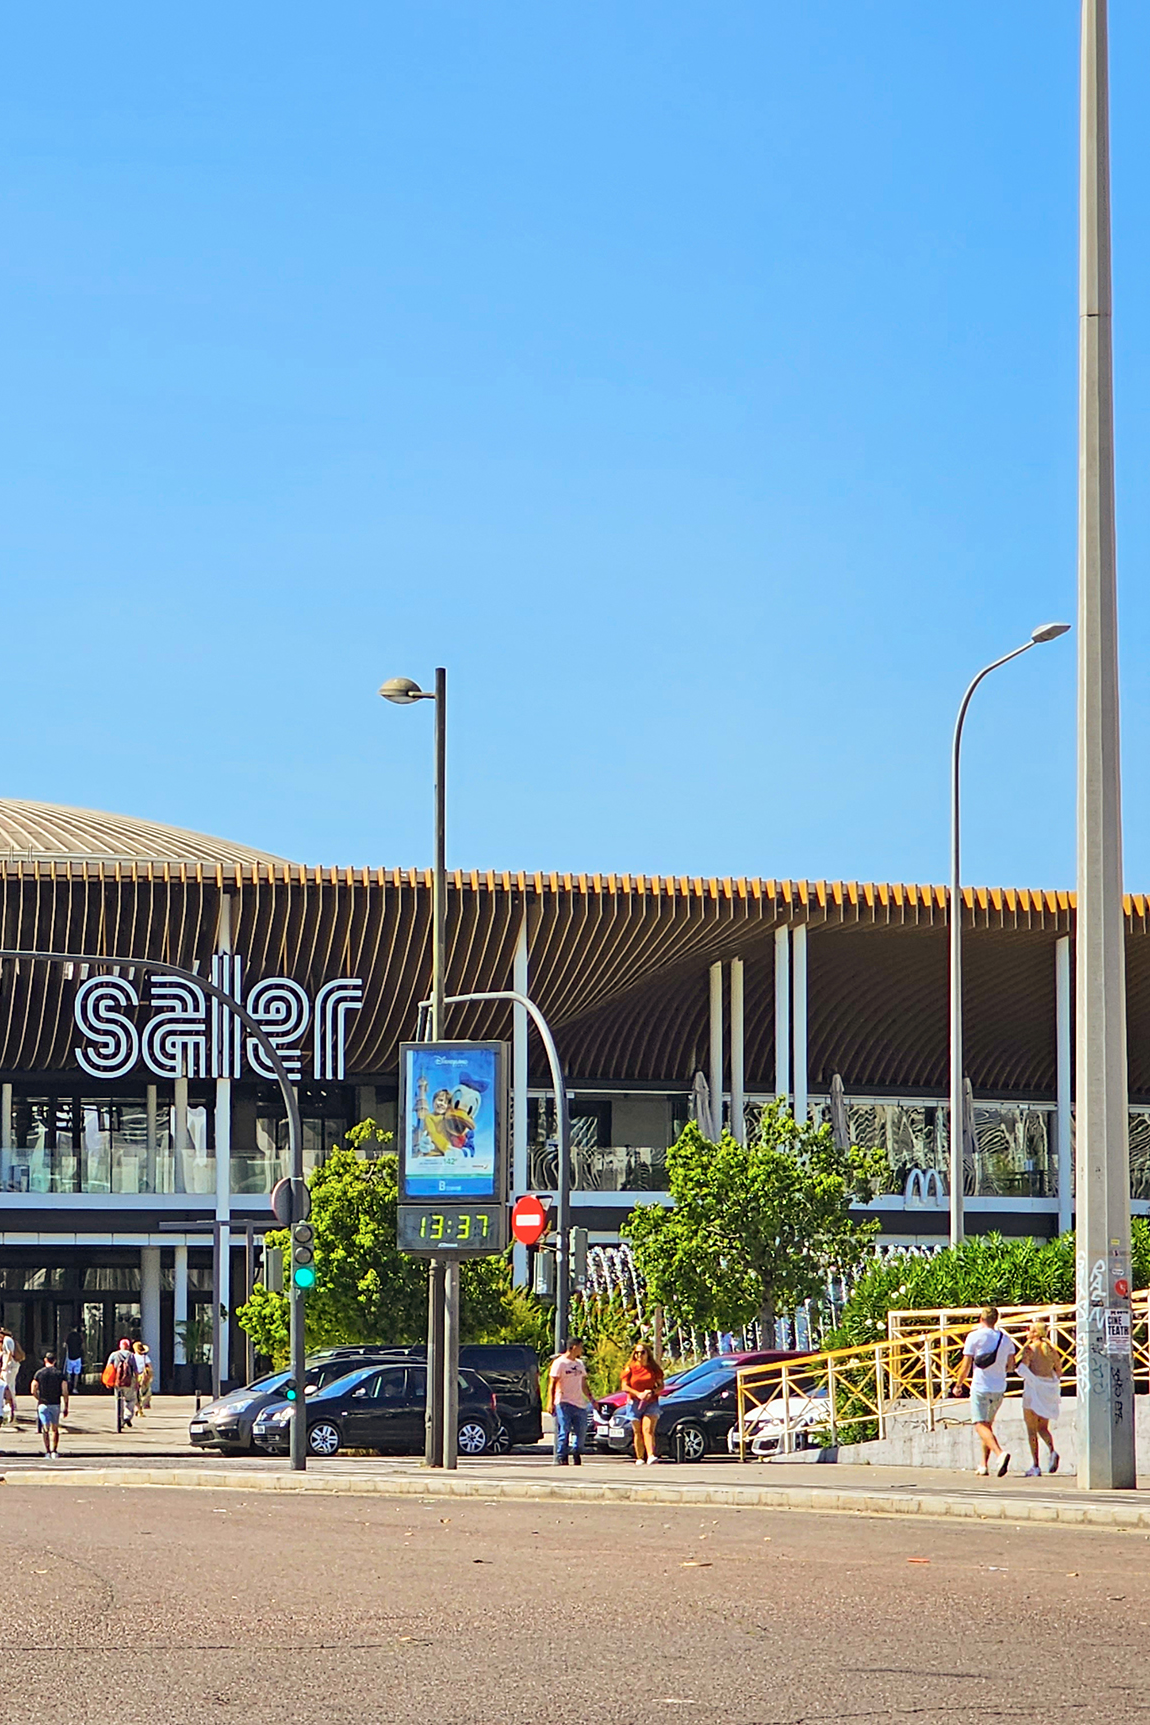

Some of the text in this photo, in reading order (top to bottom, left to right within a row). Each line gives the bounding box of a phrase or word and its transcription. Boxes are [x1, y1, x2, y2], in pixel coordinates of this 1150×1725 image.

[74, 954, 362, 1080] saler
[420, 1215, 488, 1239] 13:37
[1107, 1315, 1122, 1326] CINE
